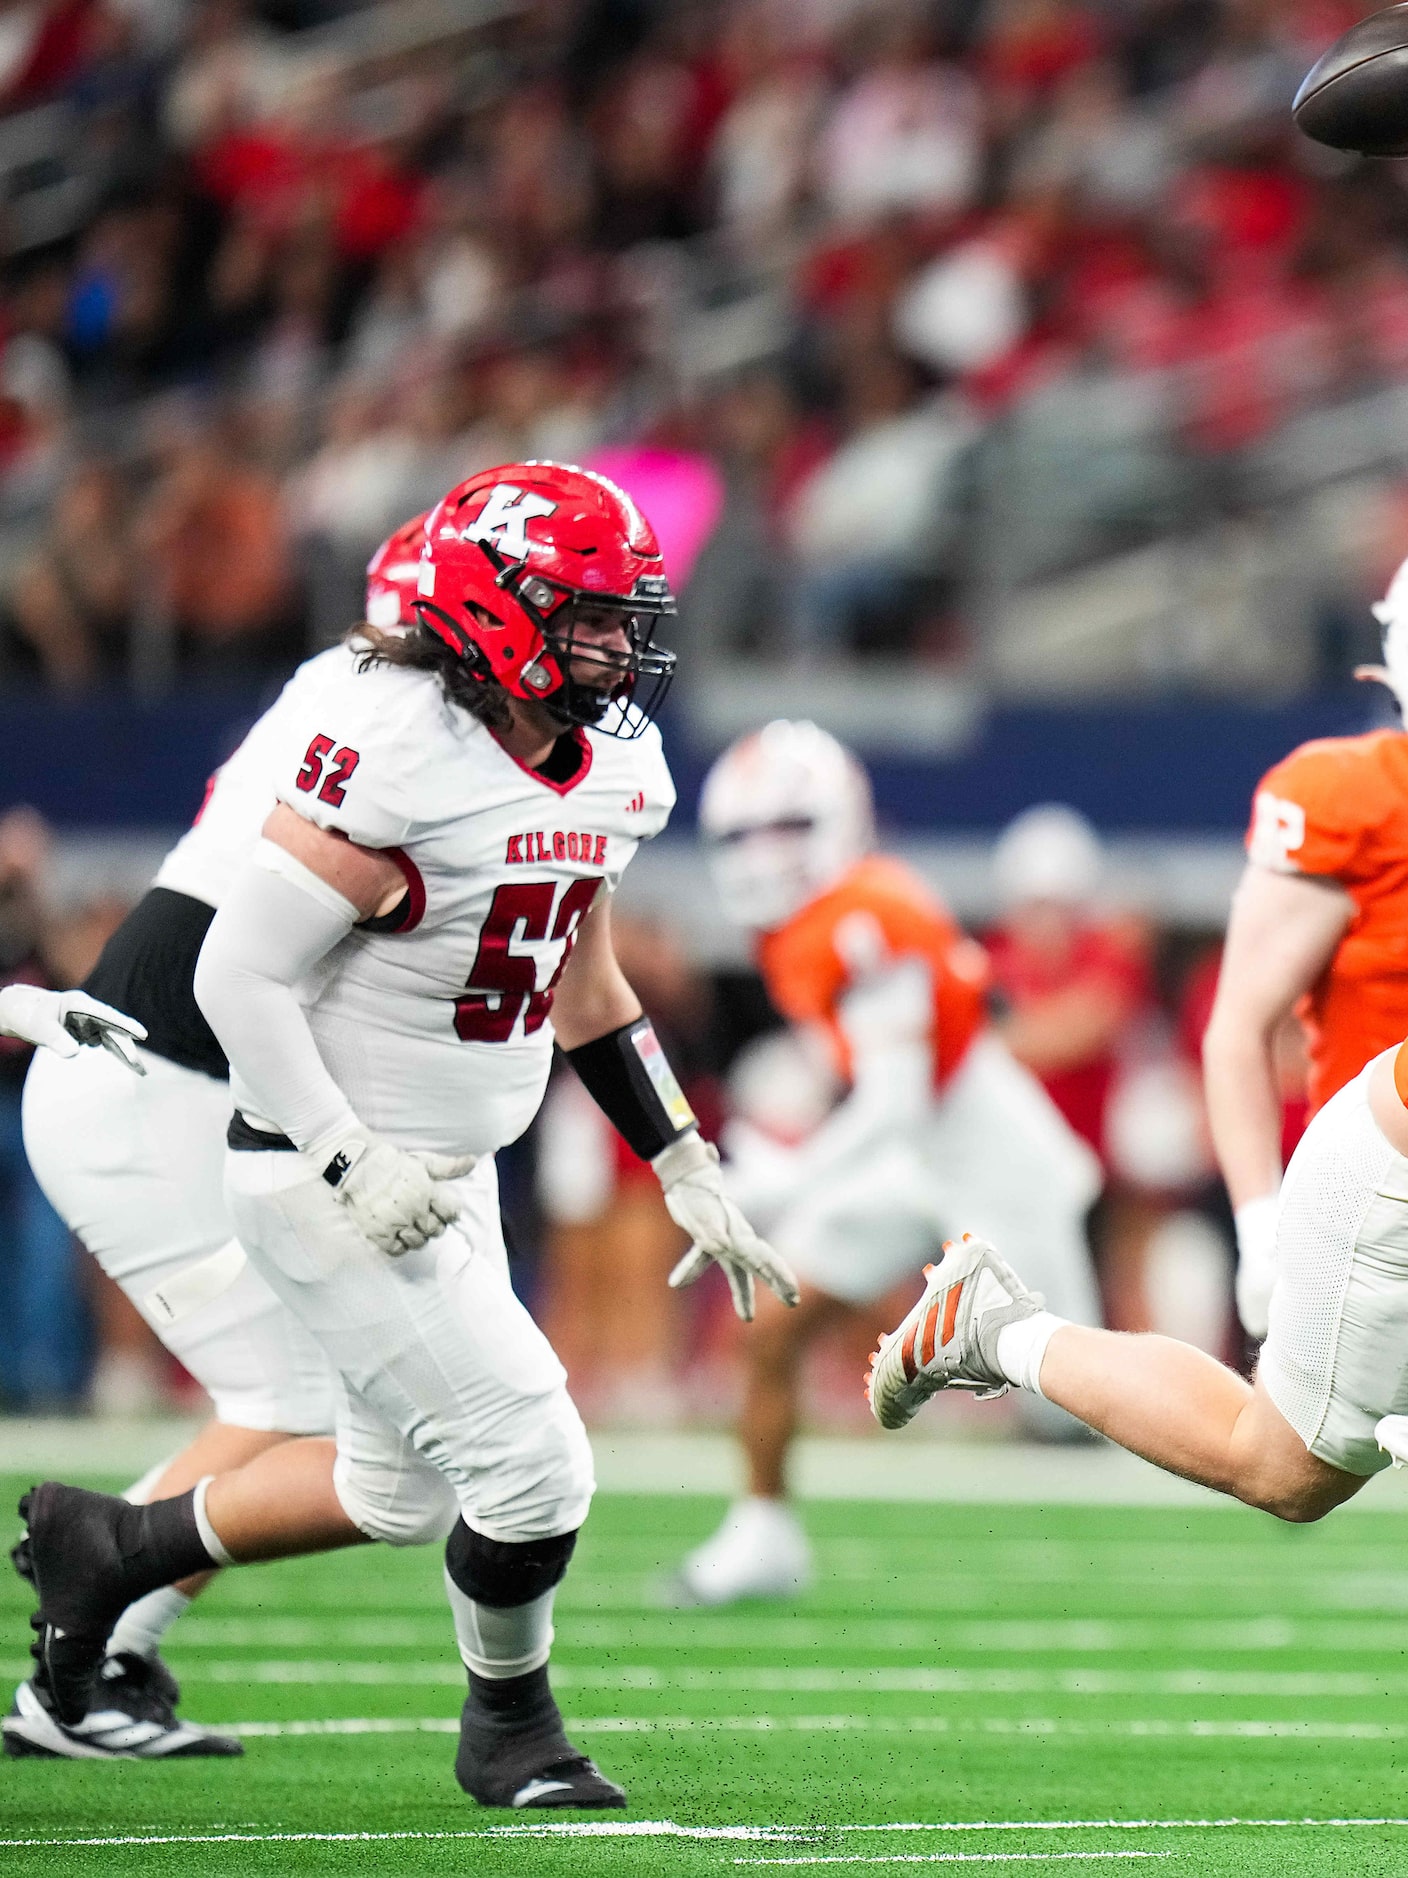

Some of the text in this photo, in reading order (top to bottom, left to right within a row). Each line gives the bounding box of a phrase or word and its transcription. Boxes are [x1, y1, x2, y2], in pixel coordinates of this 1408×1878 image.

[463, 482, 559, 561] K
[295, 733, 360, 809] 52
[505, 831, 608, 866] KILGORE
